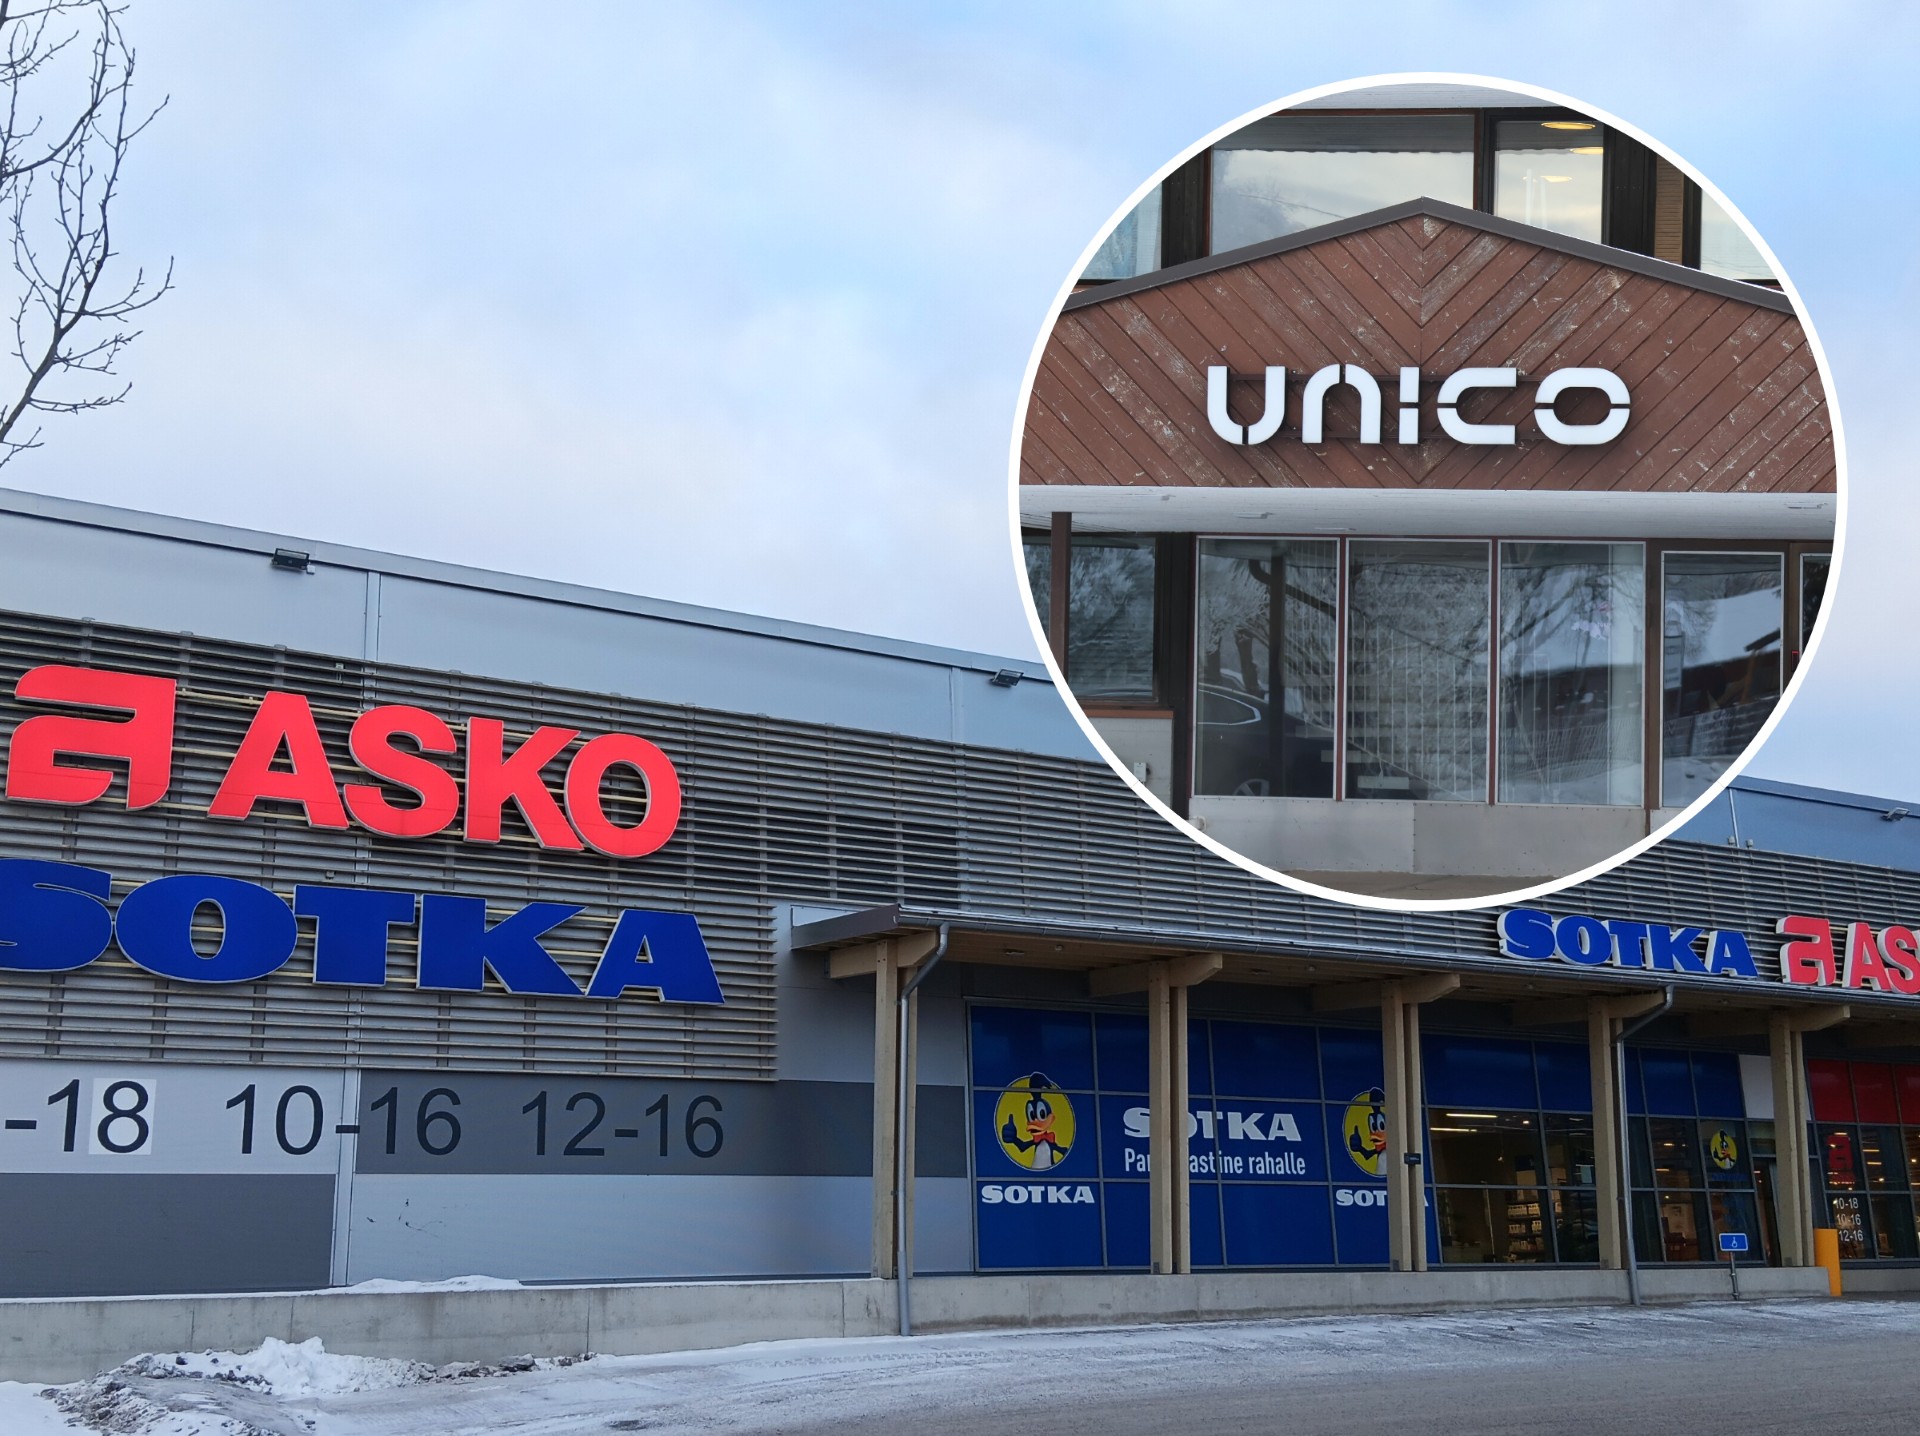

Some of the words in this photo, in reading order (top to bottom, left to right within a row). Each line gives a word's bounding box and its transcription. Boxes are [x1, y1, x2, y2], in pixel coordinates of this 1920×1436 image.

[207, 690, 682, 858] ASKO
[0, 857, 725, 1005] SOTKA
[1497, 908, 1759, 978] SOTKA
[1842, 922, 1920, 995] AS
[226, 1084, 461, 1156] 10-16
[522, 1091, 724, 1158] 12-16
[1123, 1107, 1302, 1142] STKA
[1189, 1151, 1243, 1174] astine
[1249, 1152, 1306, 1175] rahalle
[981, 1184, 1095, 1204] SOTKA
[1834, 1197, 1859, 1210] 10-18
[1836, 1213, 1862, 1226] 10-16
[1838, 1229, 1864, 1242] 12-16
